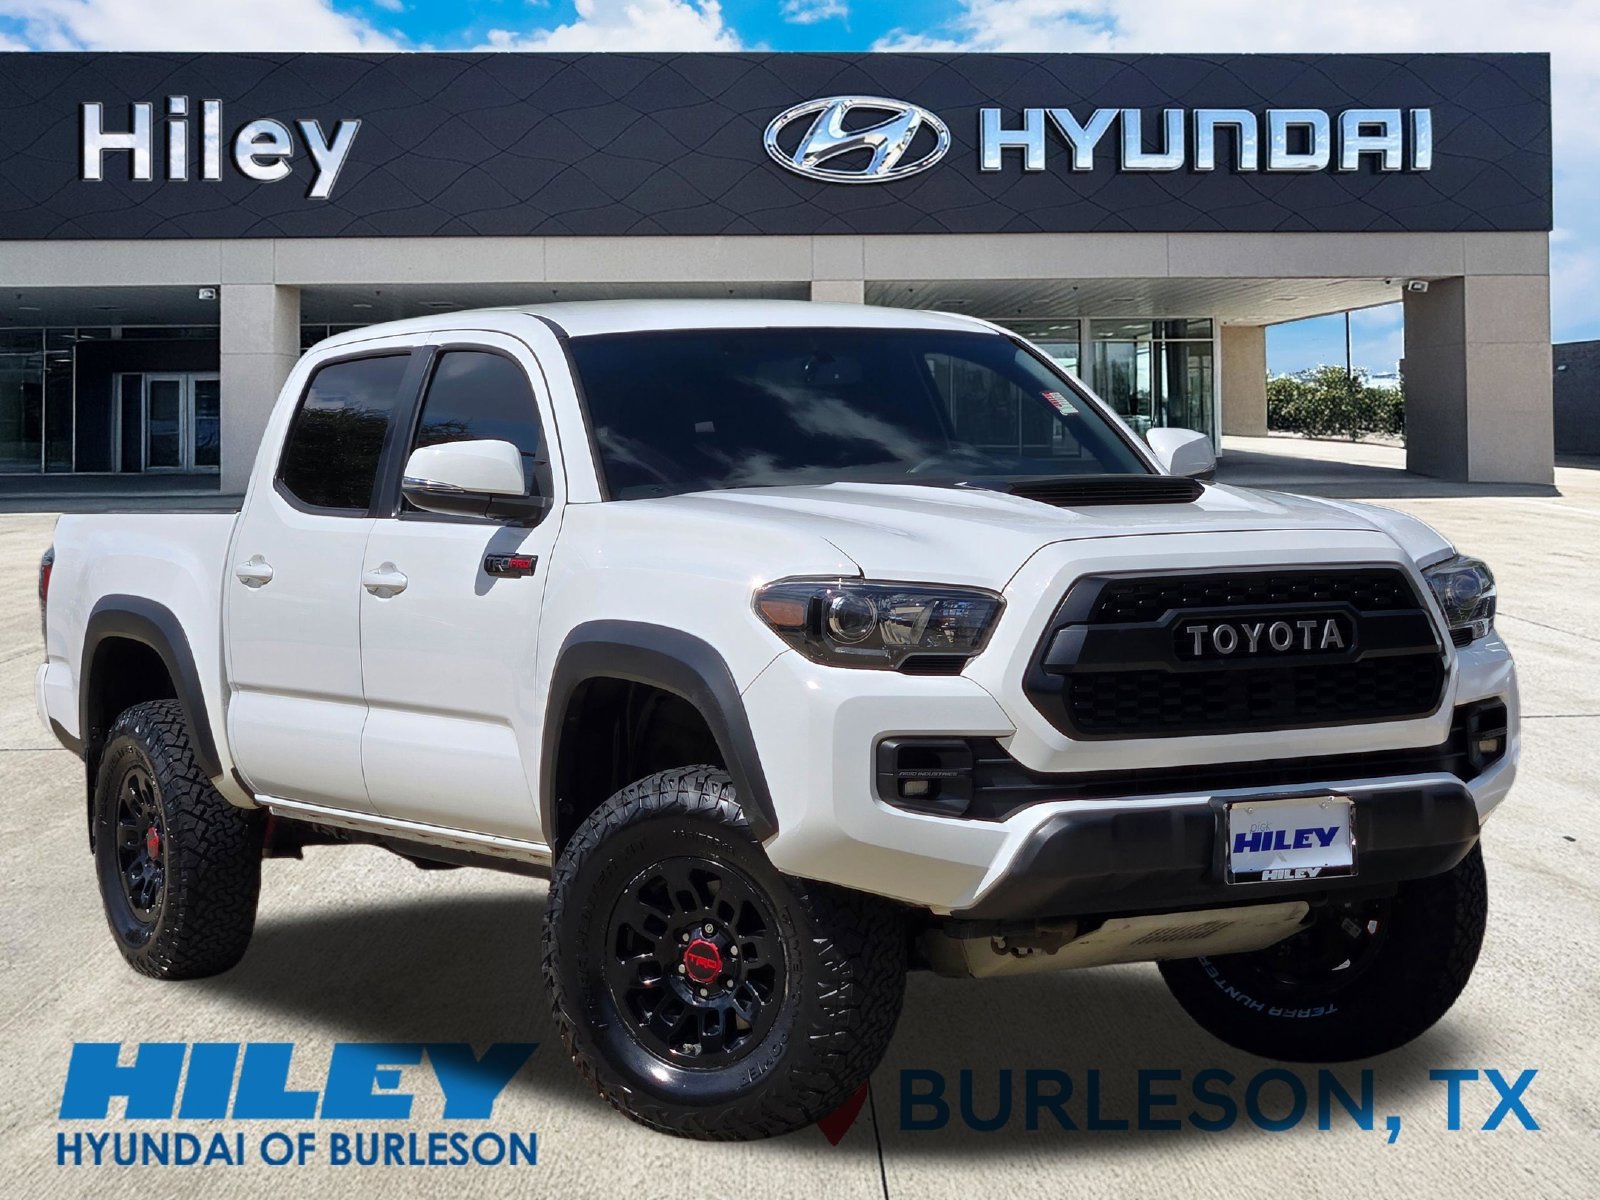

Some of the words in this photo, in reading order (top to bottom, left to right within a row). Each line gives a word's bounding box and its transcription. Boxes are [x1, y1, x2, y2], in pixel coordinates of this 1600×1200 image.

[80, 96, 360, 200] Hiley
[981, 108, 1432, 171] HYUNDAI
[1187, 620, 1344, 656] TOYOTA
[1233, 827, 1340, 853] HILEY
[1262, 867, 1322, 880] HILEY
[688, 952, 717, 968] TRD
